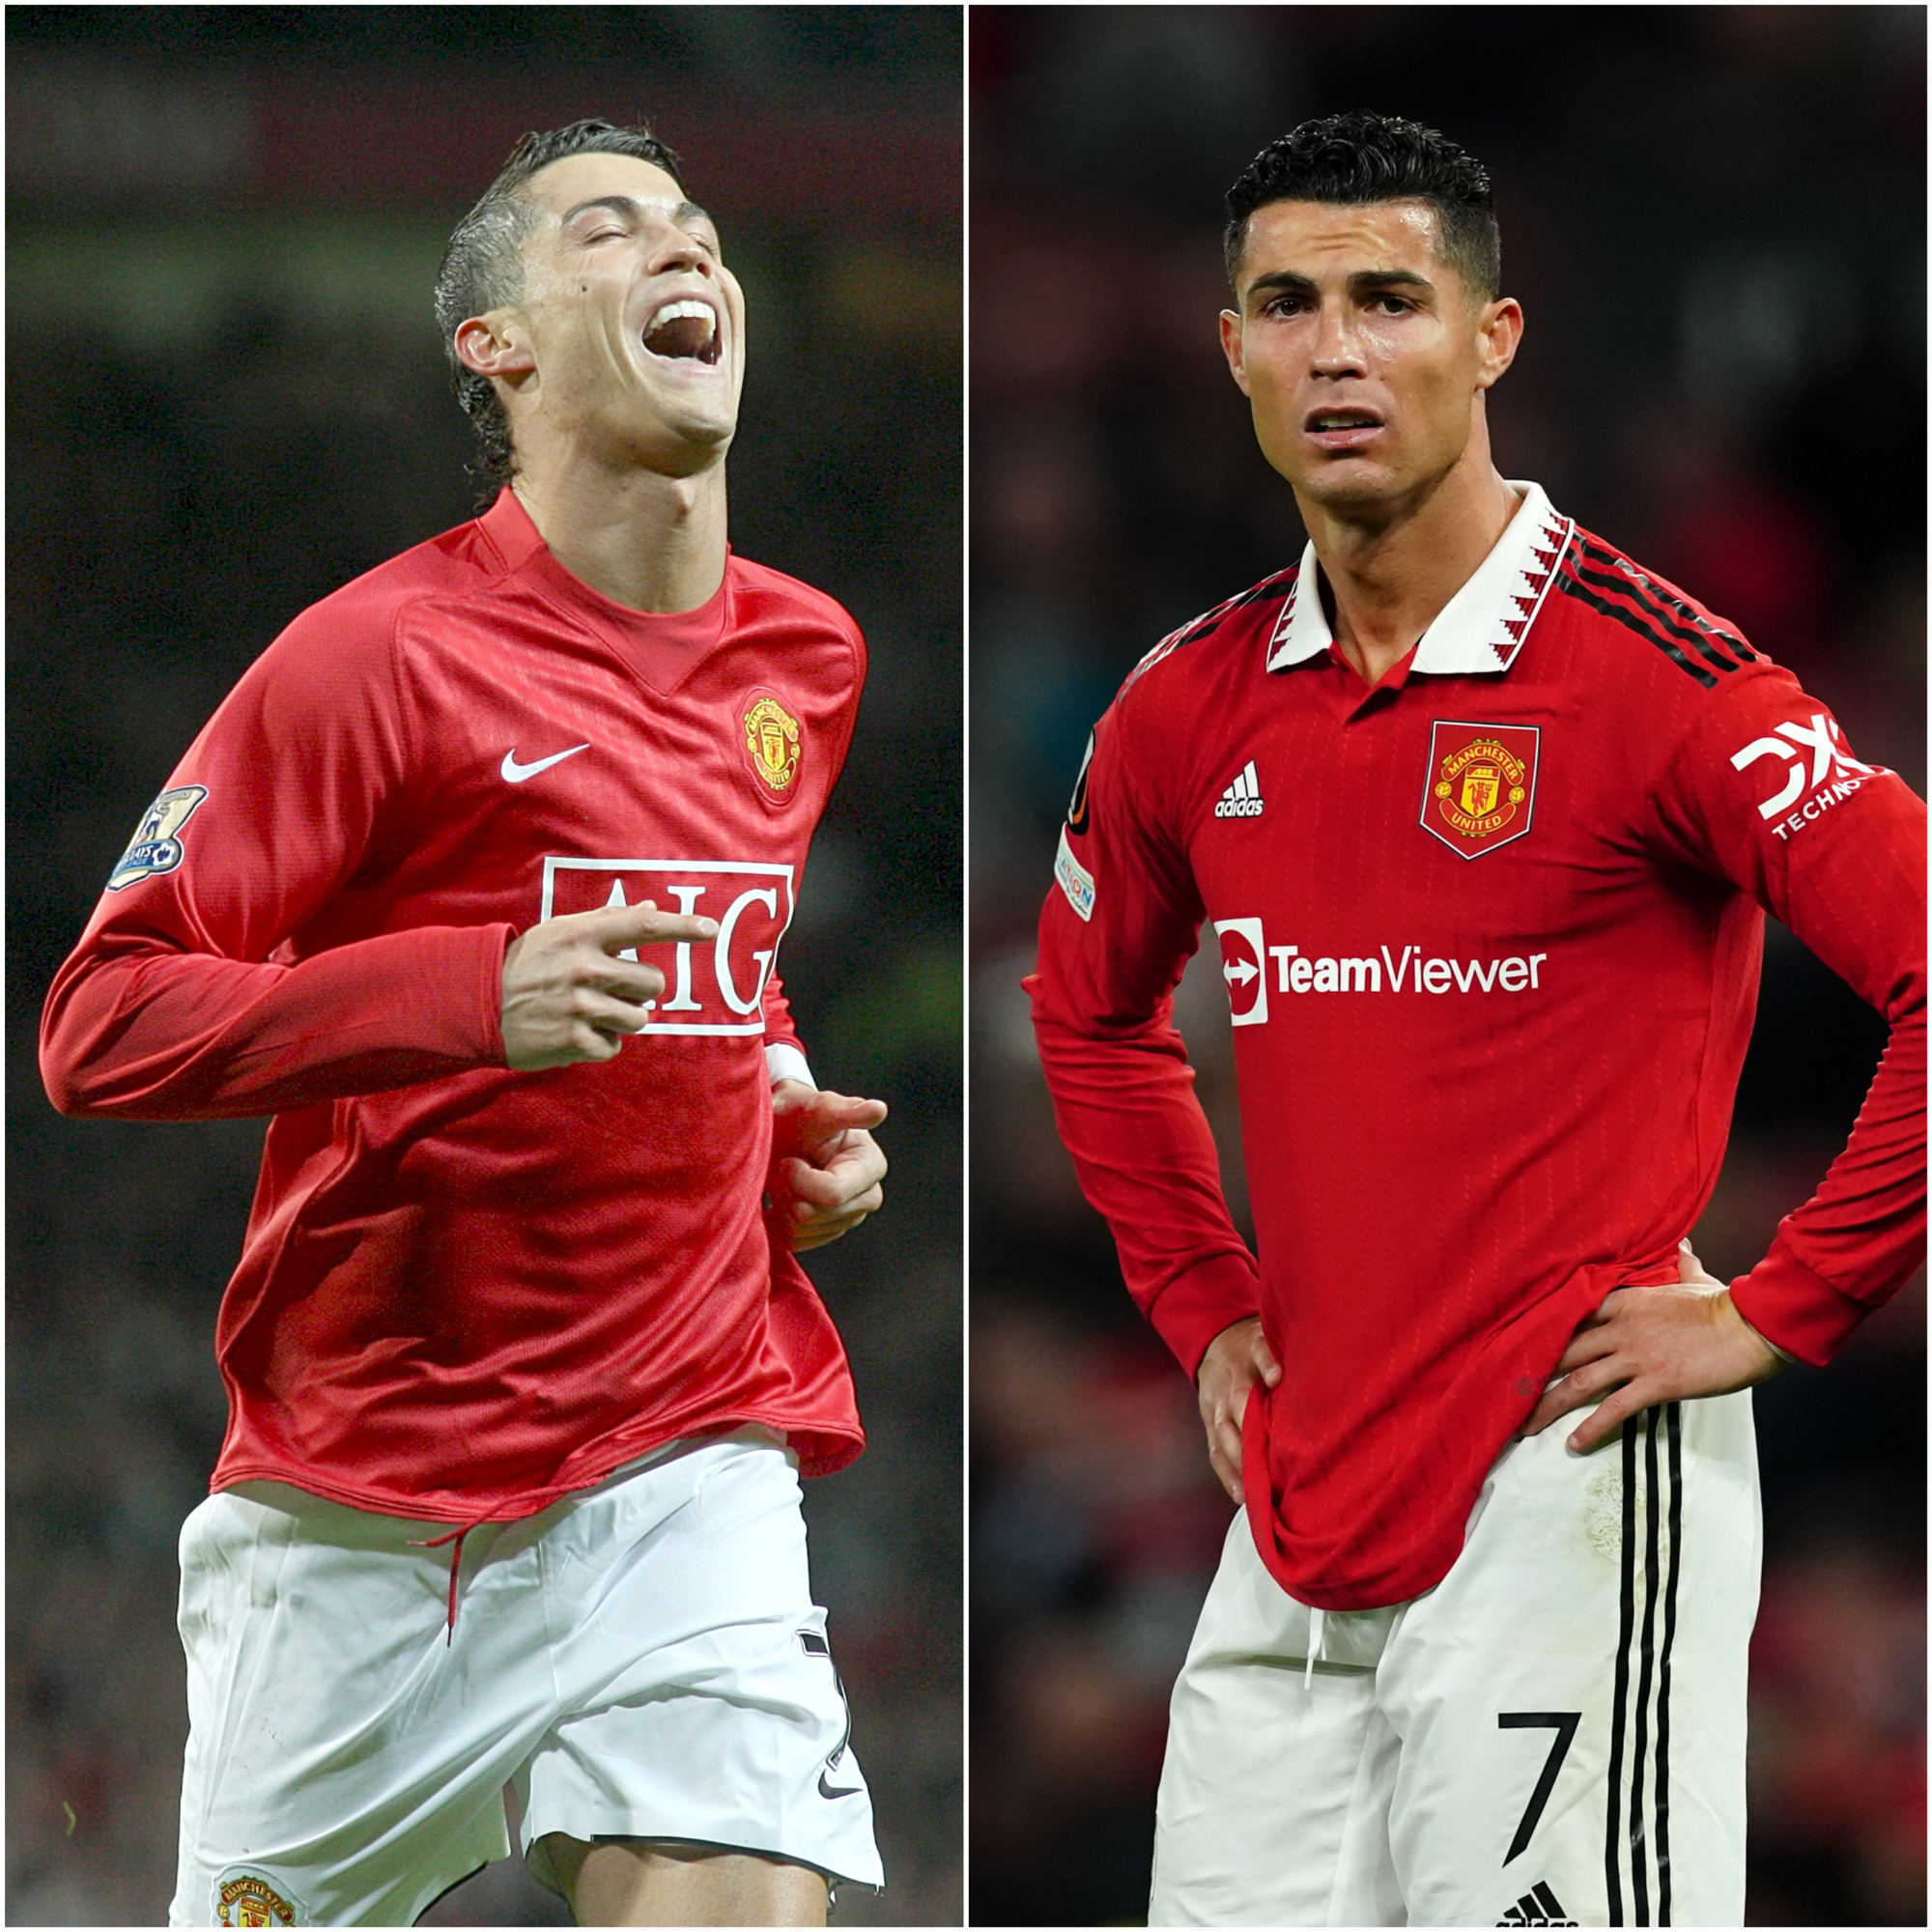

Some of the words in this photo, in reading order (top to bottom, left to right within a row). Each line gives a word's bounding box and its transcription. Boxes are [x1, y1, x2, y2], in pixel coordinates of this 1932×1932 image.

[1448, 746, 1518, 779] MANCHESTER
[1214, 797, 1264, 817] adidas
[1451, 811, 1501, 831] UNITED
[1772, 776, 1864, 840] TECHNO
[1268, 945, 1548, 995] TeamViewer
[1498, 1712, 1582, 1869] 7
[224, 1882, 289, 1918] MANCHESTER
